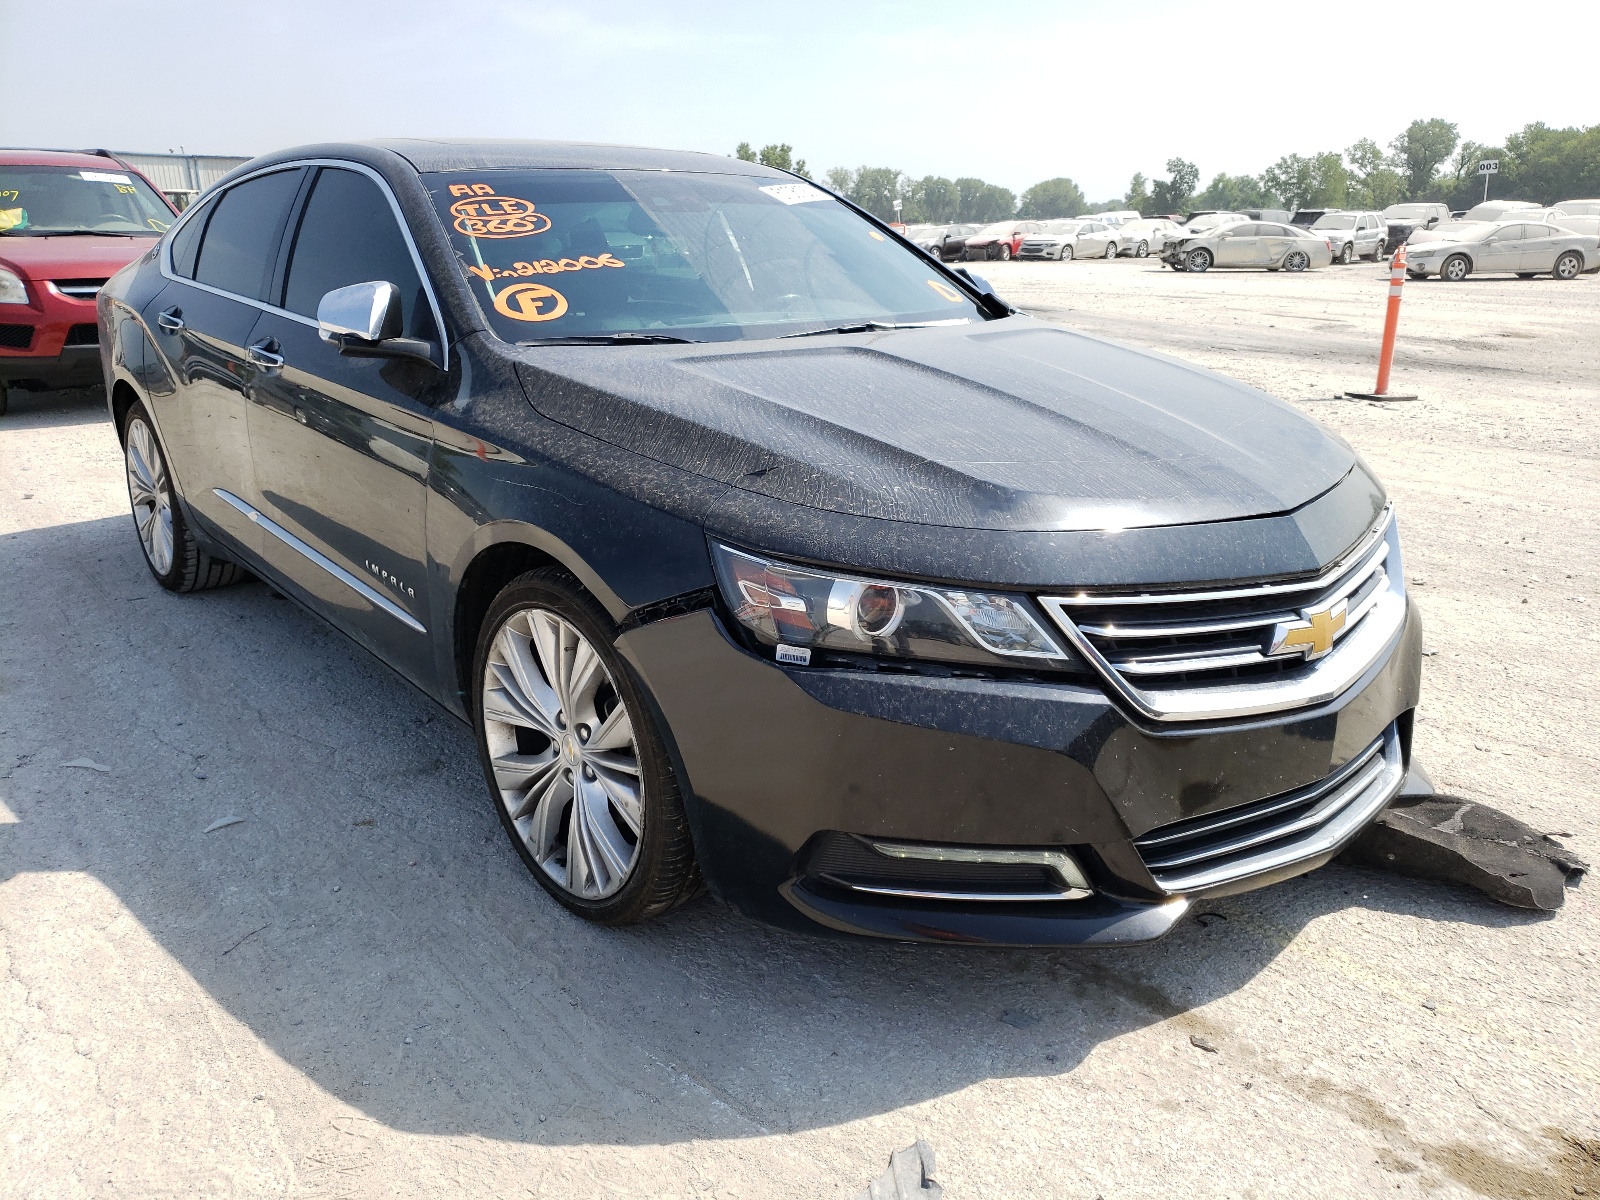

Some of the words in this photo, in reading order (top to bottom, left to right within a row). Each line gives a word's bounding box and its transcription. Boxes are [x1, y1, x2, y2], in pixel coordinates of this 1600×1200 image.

[1480, 163, 1498, 171] 003
[457, 200, 524, 217] TLE
[516, 289, 554, 317] F
[365, 559, 416, 599] IMPALA
